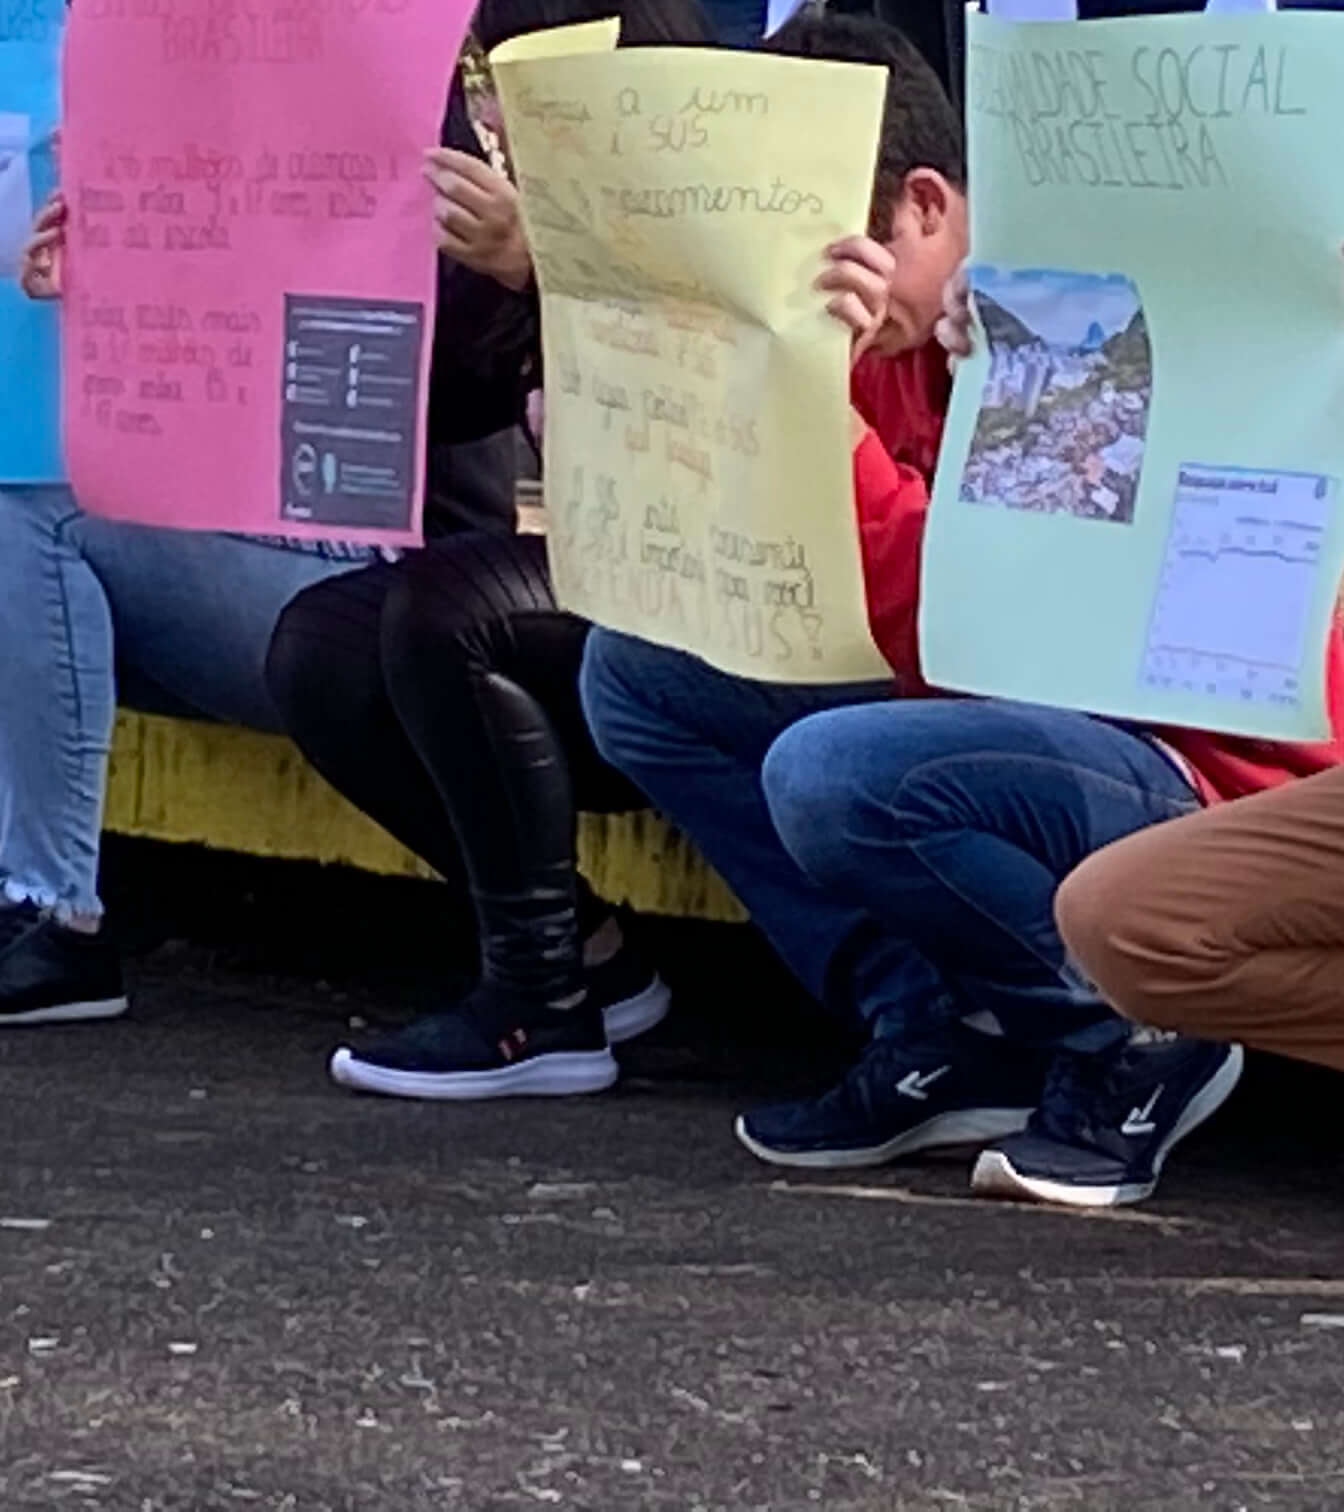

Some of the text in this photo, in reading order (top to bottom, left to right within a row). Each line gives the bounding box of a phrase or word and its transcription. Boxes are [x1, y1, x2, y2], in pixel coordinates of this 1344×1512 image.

[1129, 41, 1309, 123] SOCIAL
[646, 113, 712, 154] SUS
[1008, 118, 1232, 190] BRASILEIRA
